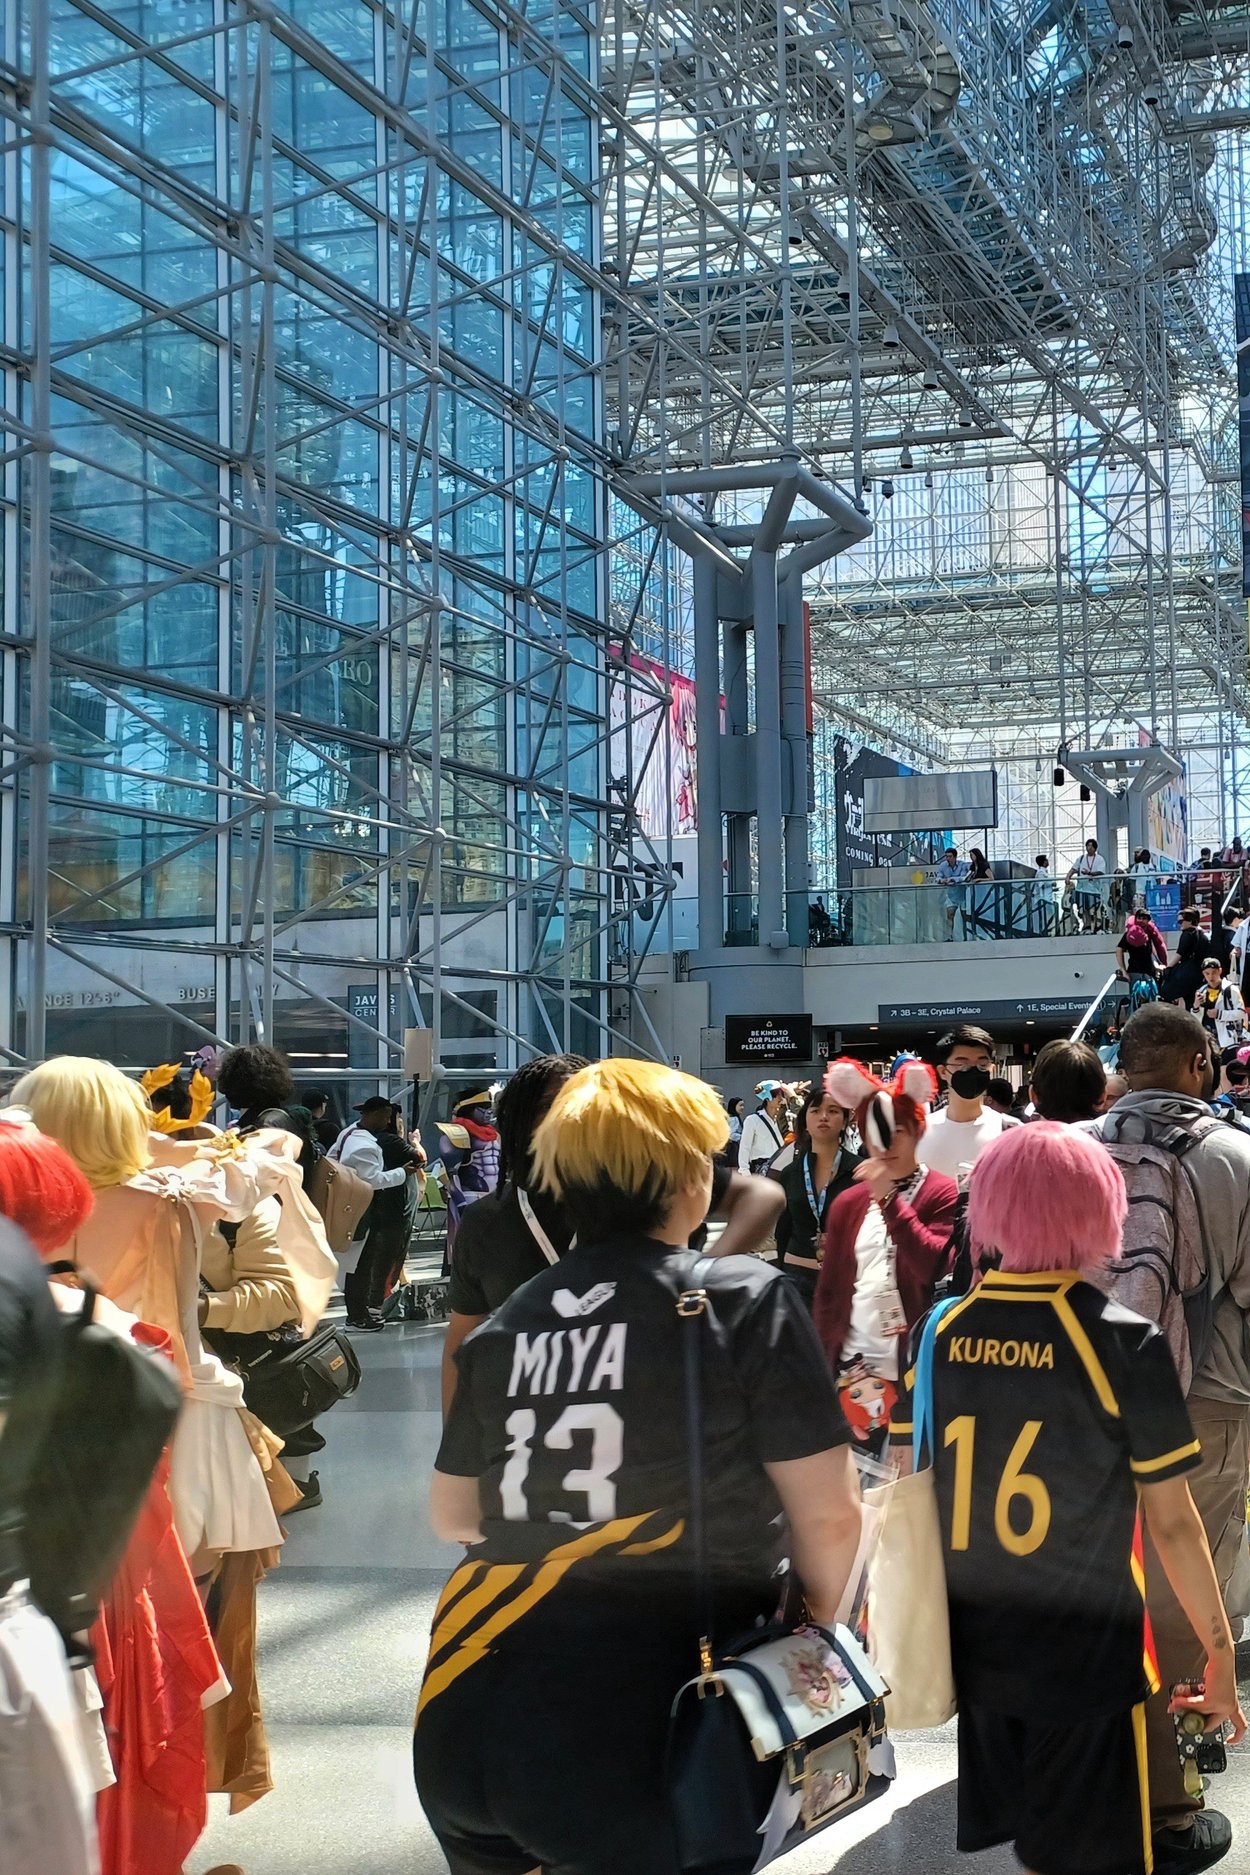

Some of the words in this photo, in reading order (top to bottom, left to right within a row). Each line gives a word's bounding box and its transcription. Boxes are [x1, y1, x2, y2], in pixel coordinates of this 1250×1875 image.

[878, 856, 893, 867] OON
[179, 986, 216, 1000] BUSE
[355, 994, 396, 1005] JAVS
[355, 1007, 396, 1017] CENR
[930, 1007, 956, 1017] Crystal
[956, 1006, 981, 1014] Palace
[1027, 1003, 1039, 1012] 1E,
[1040, 1002, 1067, 1012] Special
[948, 1336, 1055, 1370] KURONA
[506, 1323, 628, 1398] MIYA
[499, 1402, 625, 1530] 13
[943, 1415, 1052, 1557] 16
